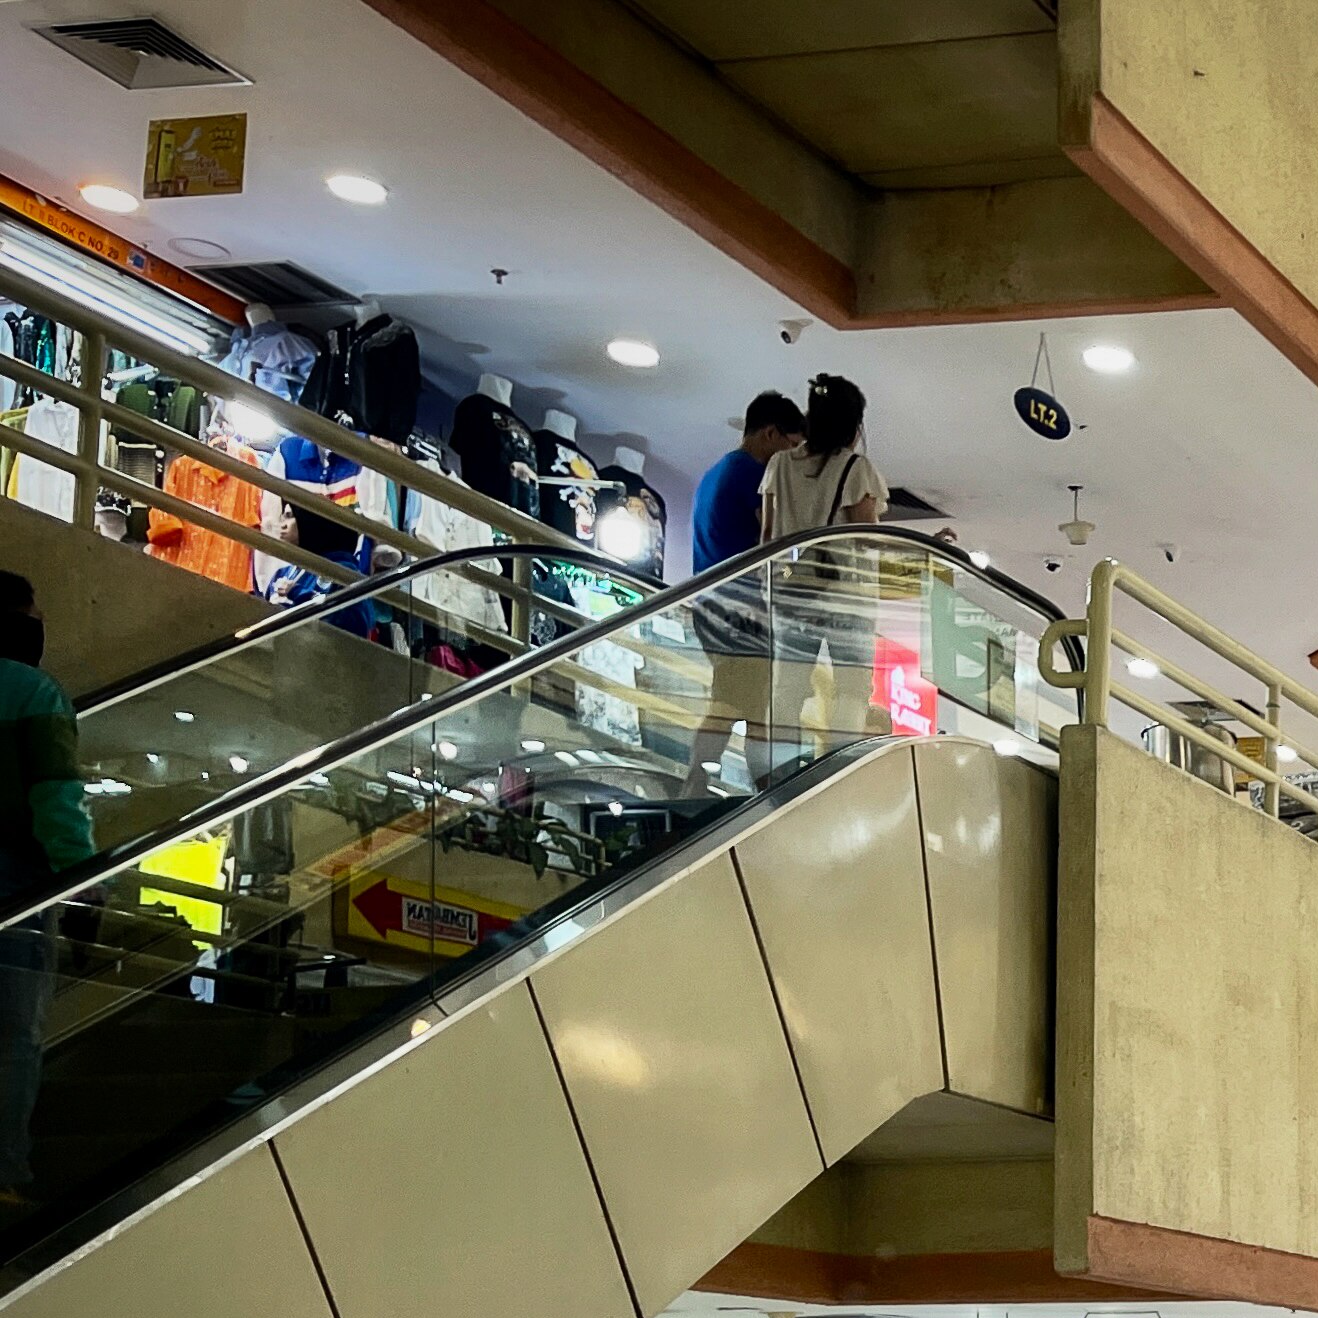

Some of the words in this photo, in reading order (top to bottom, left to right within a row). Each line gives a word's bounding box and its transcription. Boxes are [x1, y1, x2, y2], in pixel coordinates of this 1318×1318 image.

[47, 213, 76, 237] BLOK
[78, 231, 86, 243] C
[107, 246, 120, 261] 29
[1030, 399, 1058, 430] LT.2
